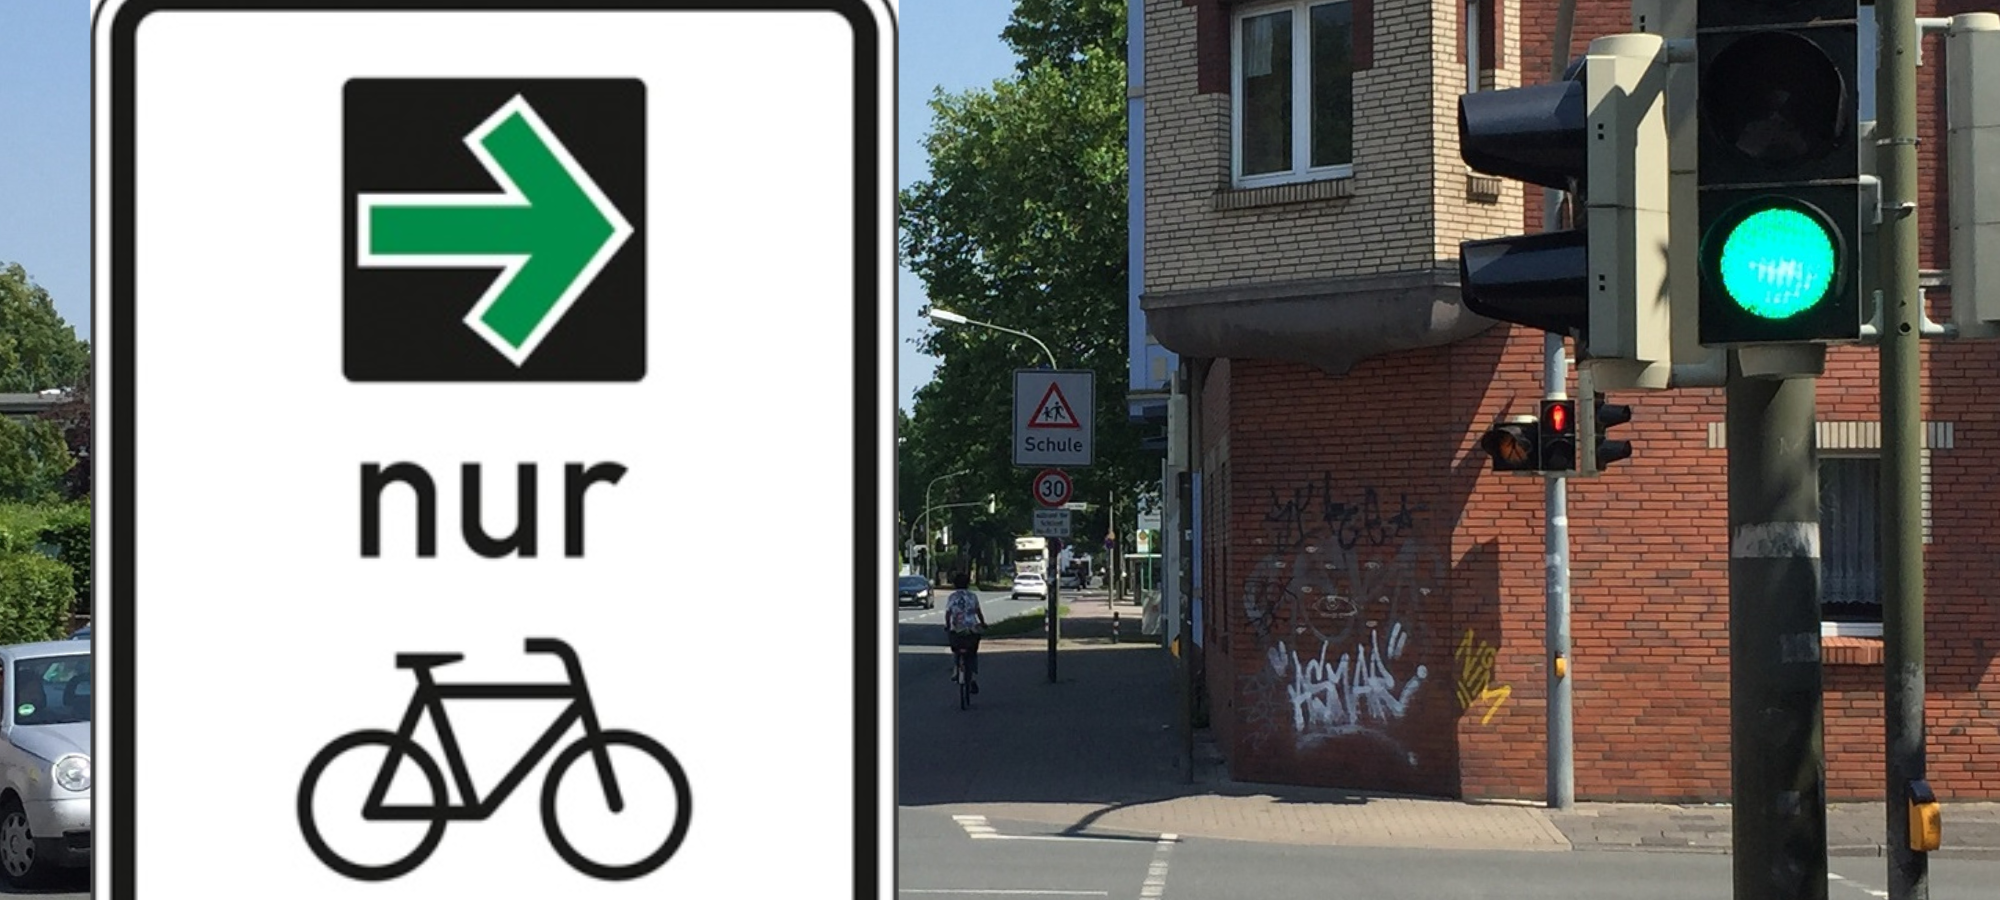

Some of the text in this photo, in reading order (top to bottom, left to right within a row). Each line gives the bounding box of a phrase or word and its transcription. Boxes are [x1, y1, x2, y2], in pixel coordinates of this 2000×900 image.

[1025, 437, 1083, 452] Schule
[1042, 480, 1065, 498] 30
[360, 461, 627, 558] nur
